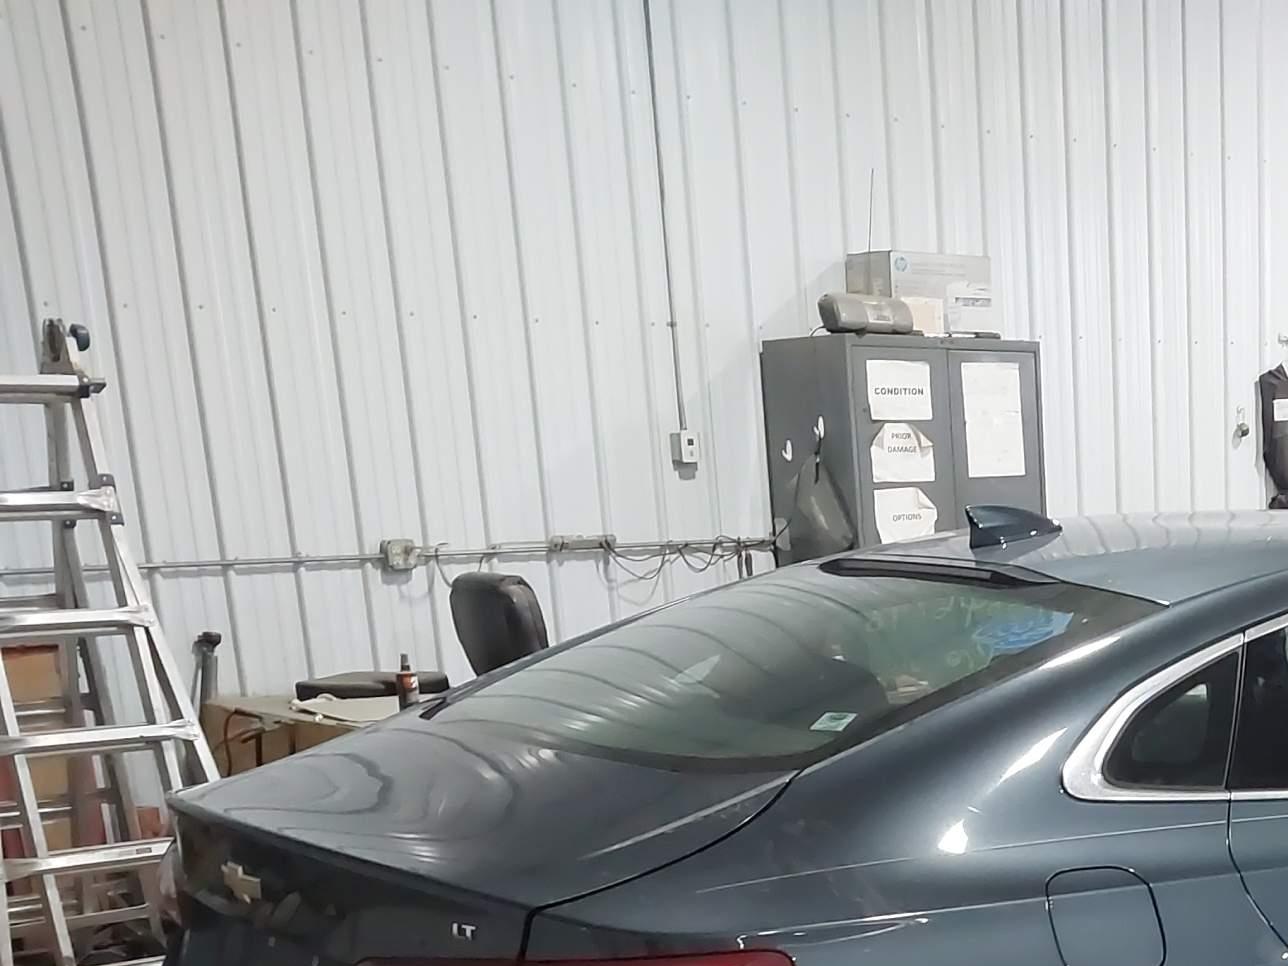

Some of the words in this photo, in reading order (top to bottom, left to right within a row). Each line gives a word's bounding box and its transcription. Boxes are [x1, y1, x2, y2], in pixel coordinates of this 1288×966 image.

[874, 387, 924, 396] CONDITION
[891, 432, 912, 440] PRIOR
[887, 446, 918, 454] DAMAGE
[892, 513, 922, 522] OPTIONS
[452, 922, 476, 941] LT
